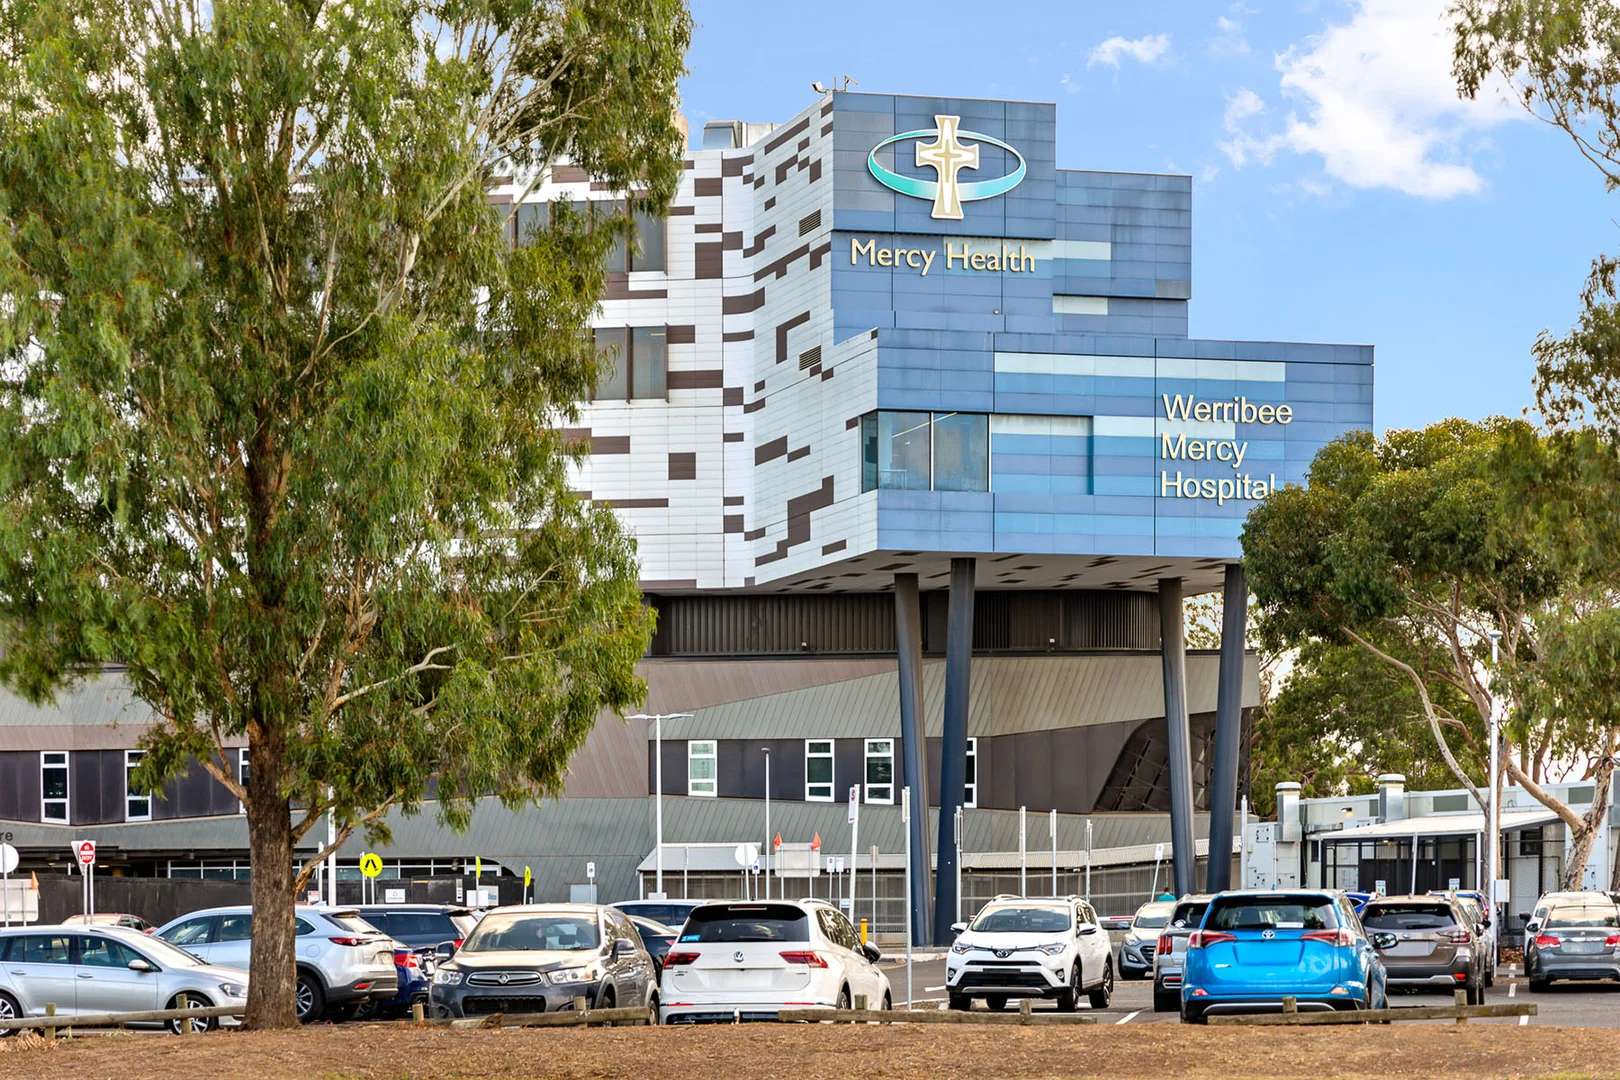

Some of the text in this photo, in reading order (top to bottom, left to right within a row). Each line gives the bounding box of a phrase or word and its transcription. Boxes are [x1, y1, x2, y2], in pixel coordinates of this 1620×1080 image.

[851, 238, 1035, 276] Mercy Health
[1163, 394, 1293, 425] Werribee
[1161, 433, 1248, 468] Mercy
[1160, 470, 1274, 505] Hospital
